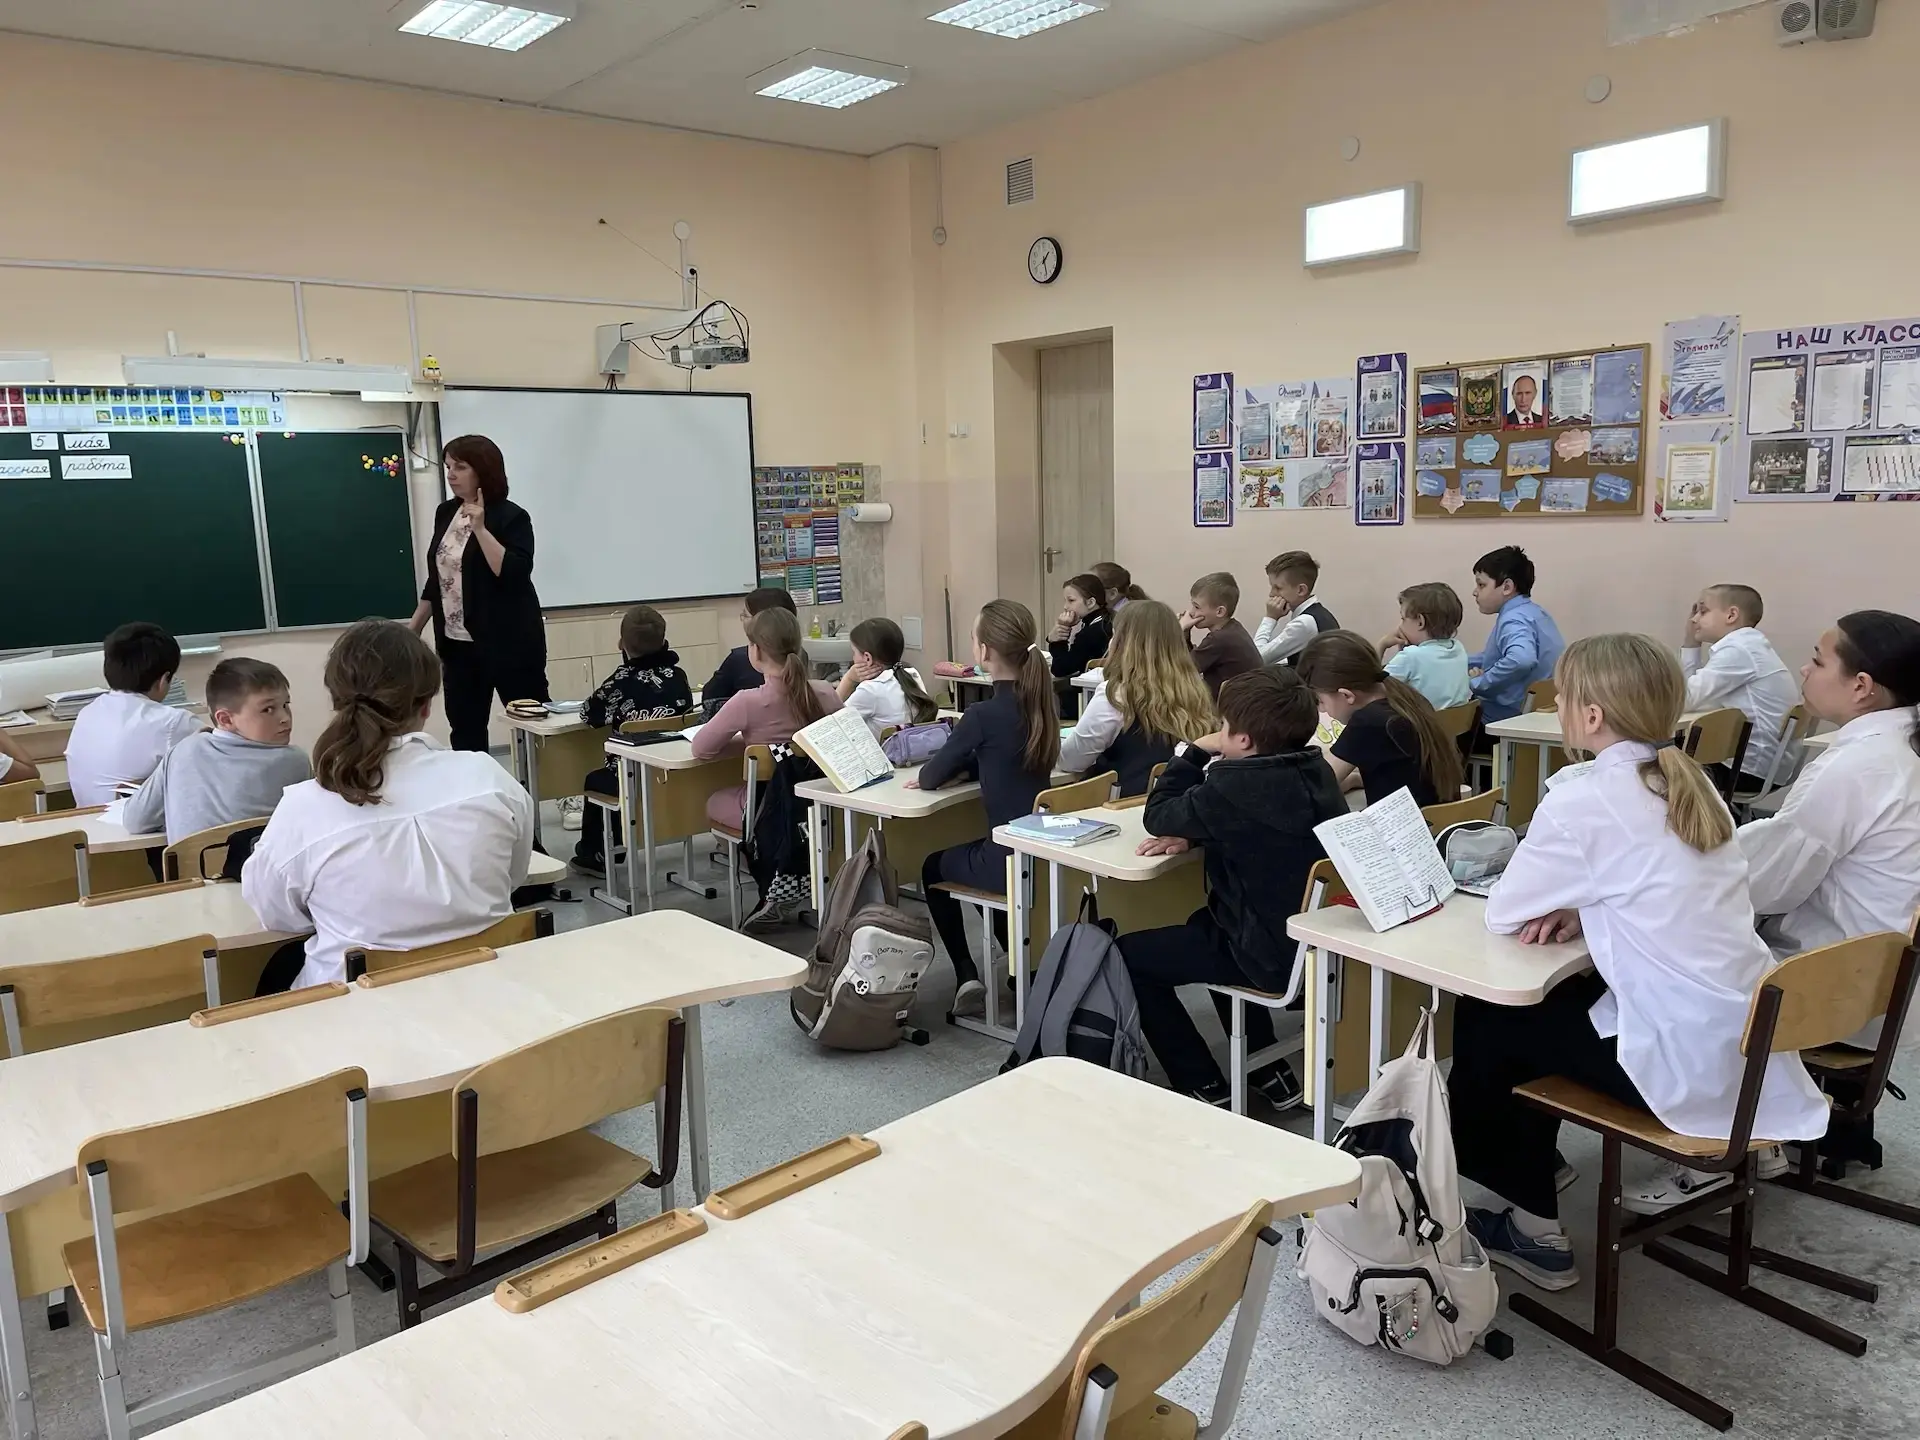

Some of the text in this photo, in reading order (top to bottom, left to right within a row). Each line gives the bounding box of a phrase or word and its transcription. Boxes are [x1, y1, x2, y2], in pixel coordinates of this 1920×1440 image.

[1776, 323, 1920, 350] НАШ КЛАСС
[1682, 343, 1720, 353] ГРАМОТА
[161, 408, 175, 422] Т
[241, 409, 254, 423] Ч
[255, 409, 269, 425] Щ
[34, 435, 46, 448] 5
